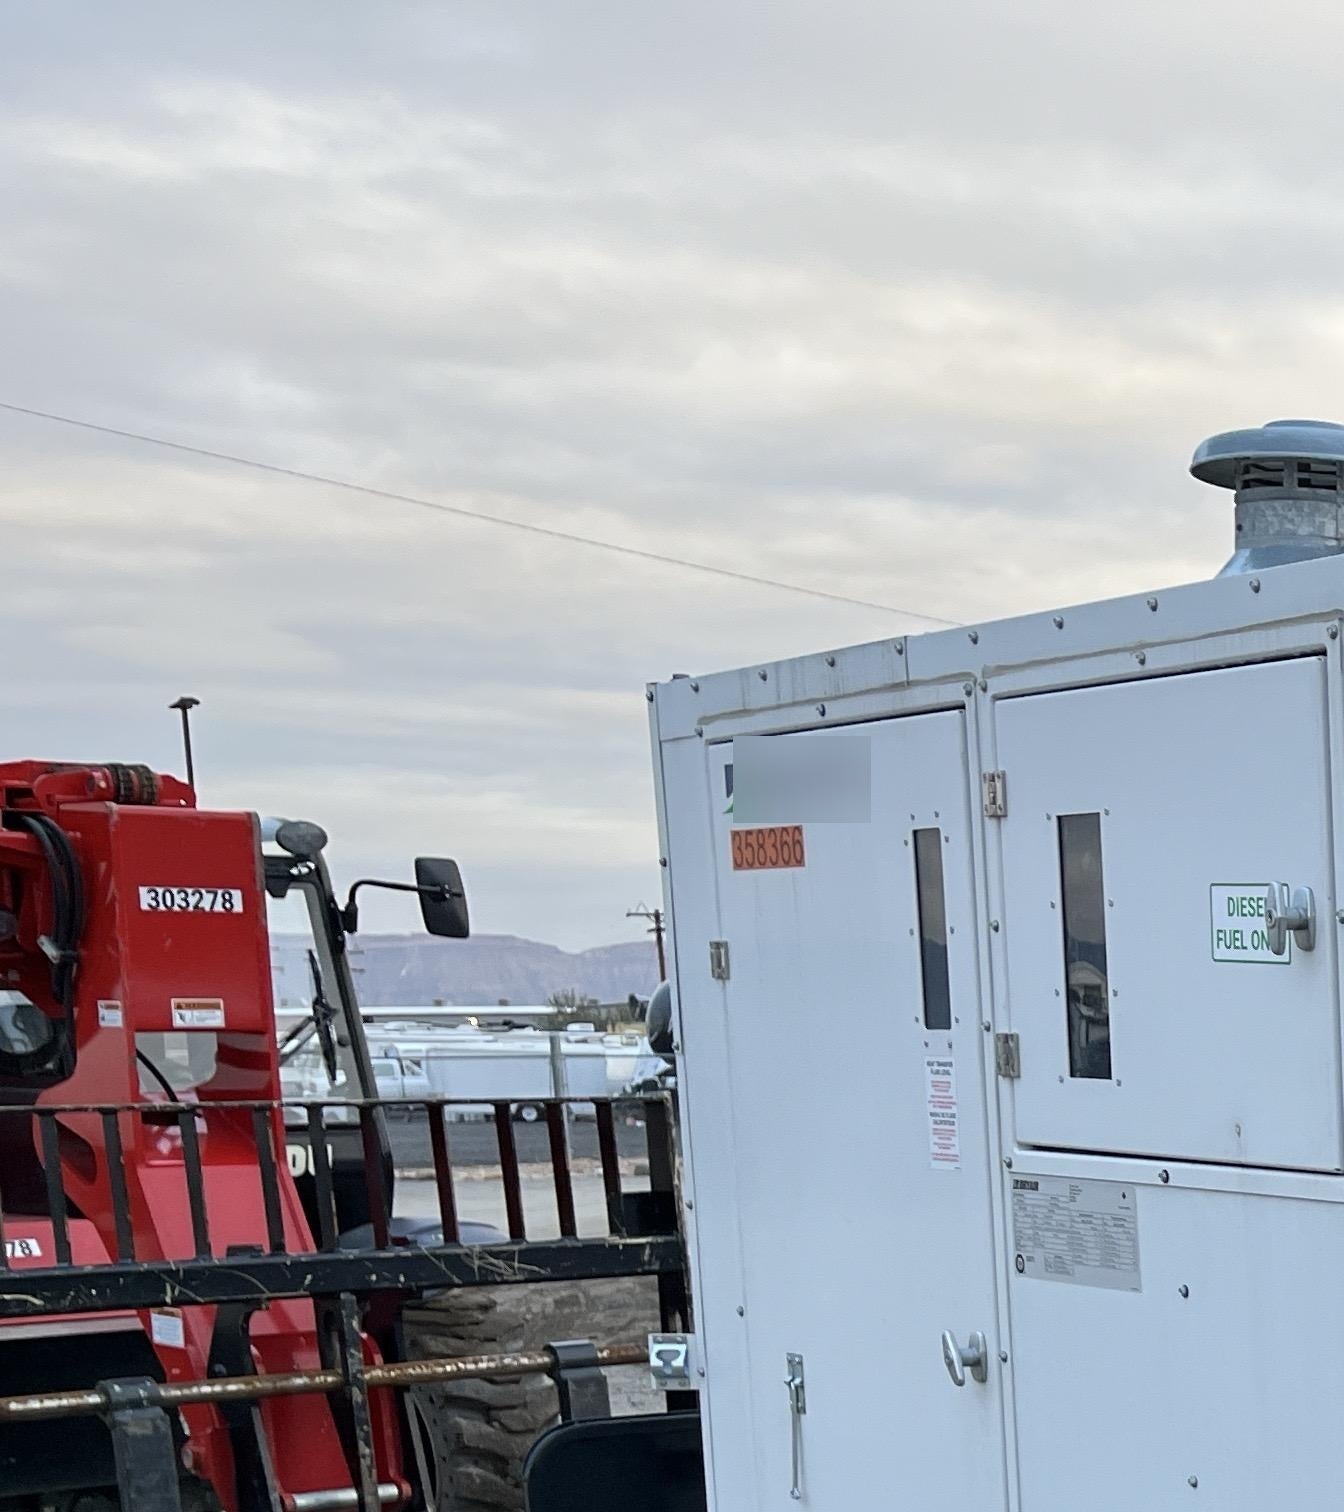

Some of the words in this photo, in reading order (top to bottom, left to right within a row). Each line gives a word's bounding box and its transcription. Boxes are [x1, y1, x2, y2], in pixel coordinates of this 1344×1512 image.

[732, 826, 805, 869] 358366
[146, 888, 234, 911] 303278
[1227, 896, 1268, 918] DIESE
[1216, 929, 1248, 950] FUEL
[1250, 929, 1271, 951] ON
